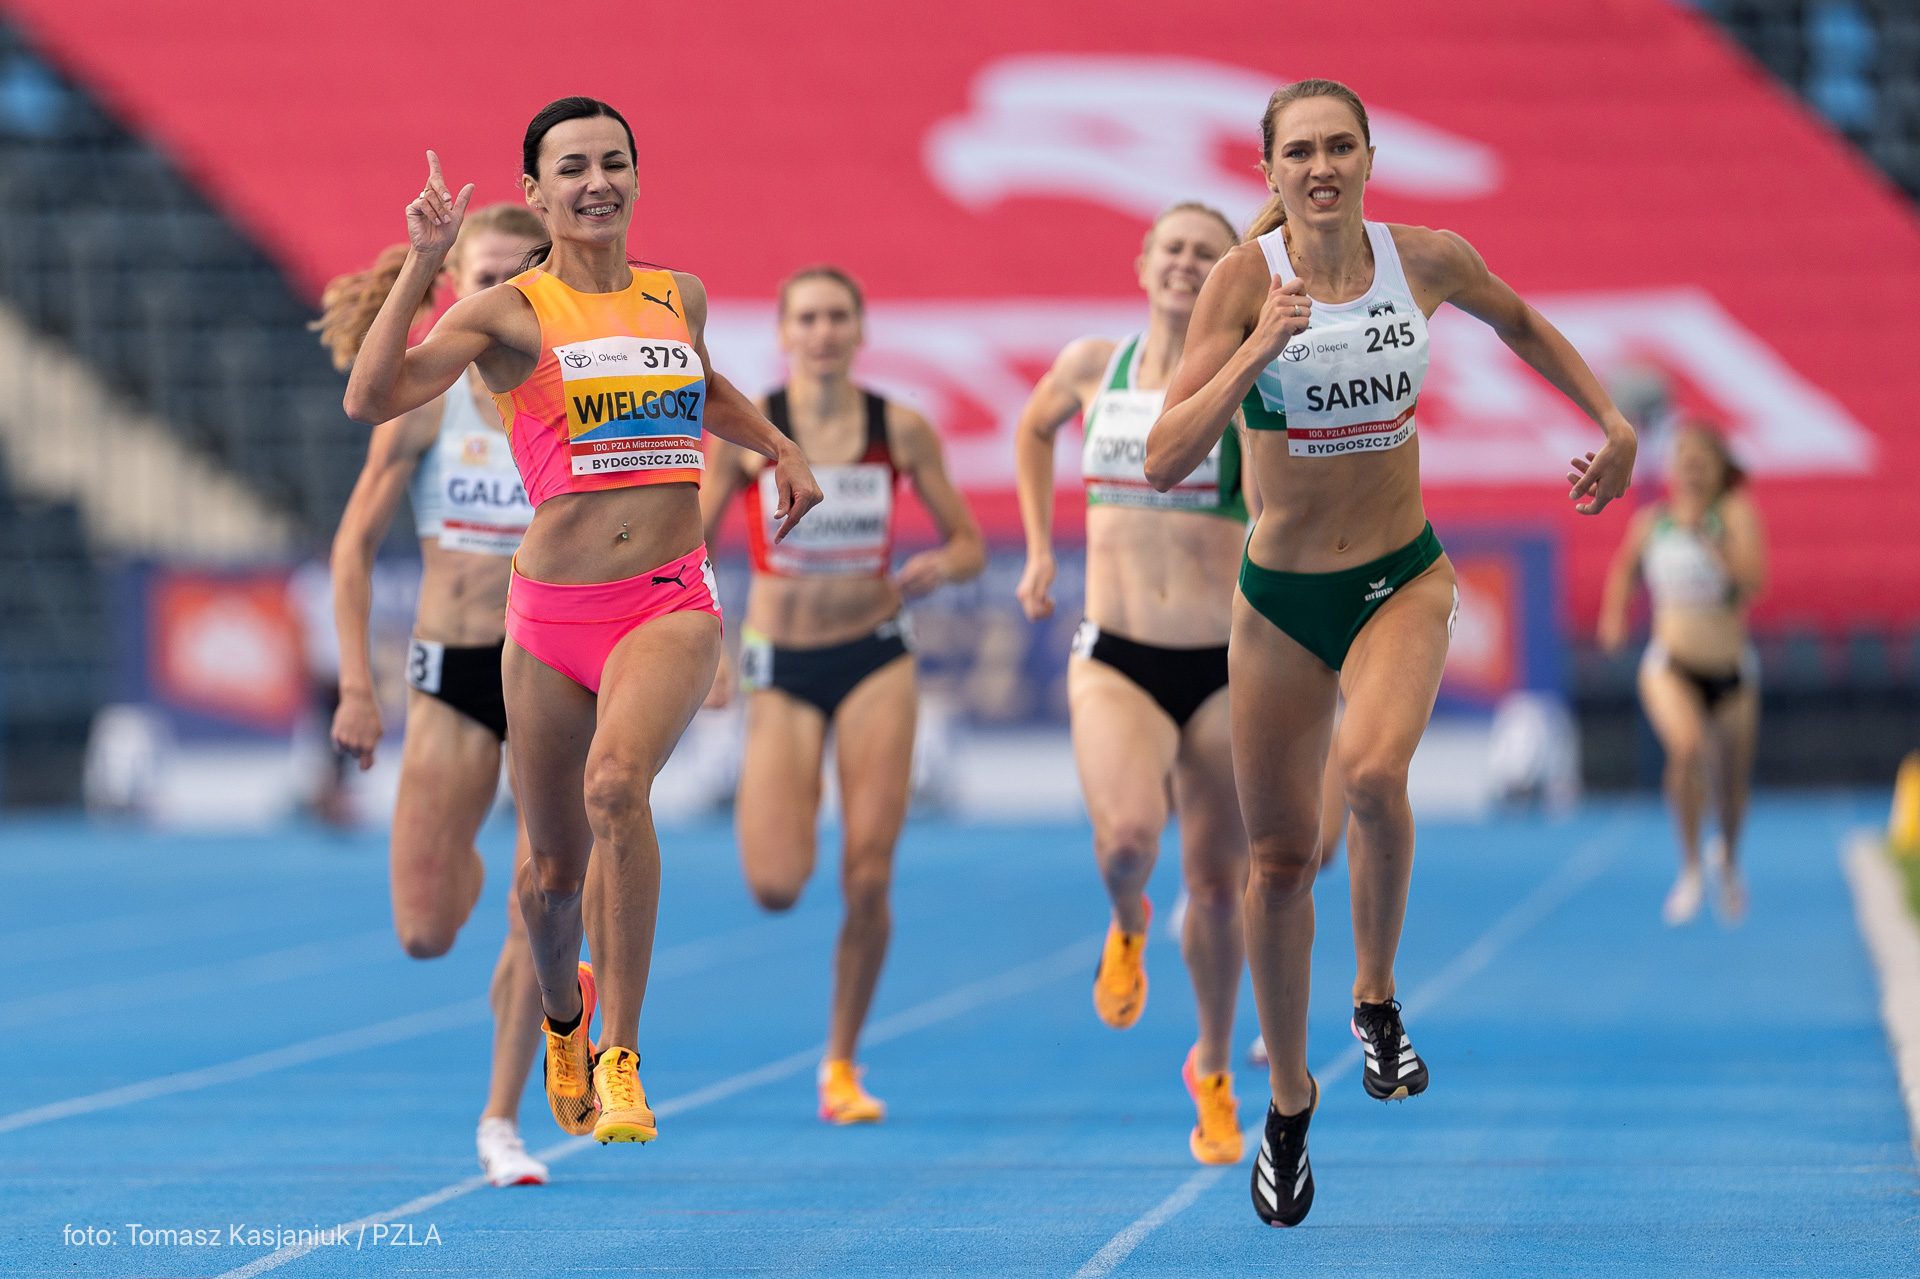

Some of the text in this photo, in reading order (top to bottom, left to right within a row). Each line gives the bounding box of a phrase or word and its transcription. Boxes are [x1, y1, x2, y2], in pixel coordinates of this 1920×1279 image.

[1364, 321, 1415, 354] 245
[598, 353, 628, 363] Okęcie
[640, 346, 689, 369] 379
[1316, 341, 1349, 355] Okęcie
[1306, 371, 1412, 412] SARNA
[572, 389, 701, 425] WIELGOSZ
[1308, 430, 1325, 439] 100.
[1326, 428, 1347, 438] PZLA
[1347, 421, 1397, 435] Mistrzostwa
[1308, 426, 1409, 454] BYDGOSZCZ 2024
[592, 443, 610, 452] 100.
[611, 441, 631, 450] PZLA
[632, 439, 679, 449] Mistrzostwa
[592, 453, 699, 470] BYDGOSZCZ 2024
[447, 477, 528, 507] GALA
[1364, 586, 1394, 602] erima
